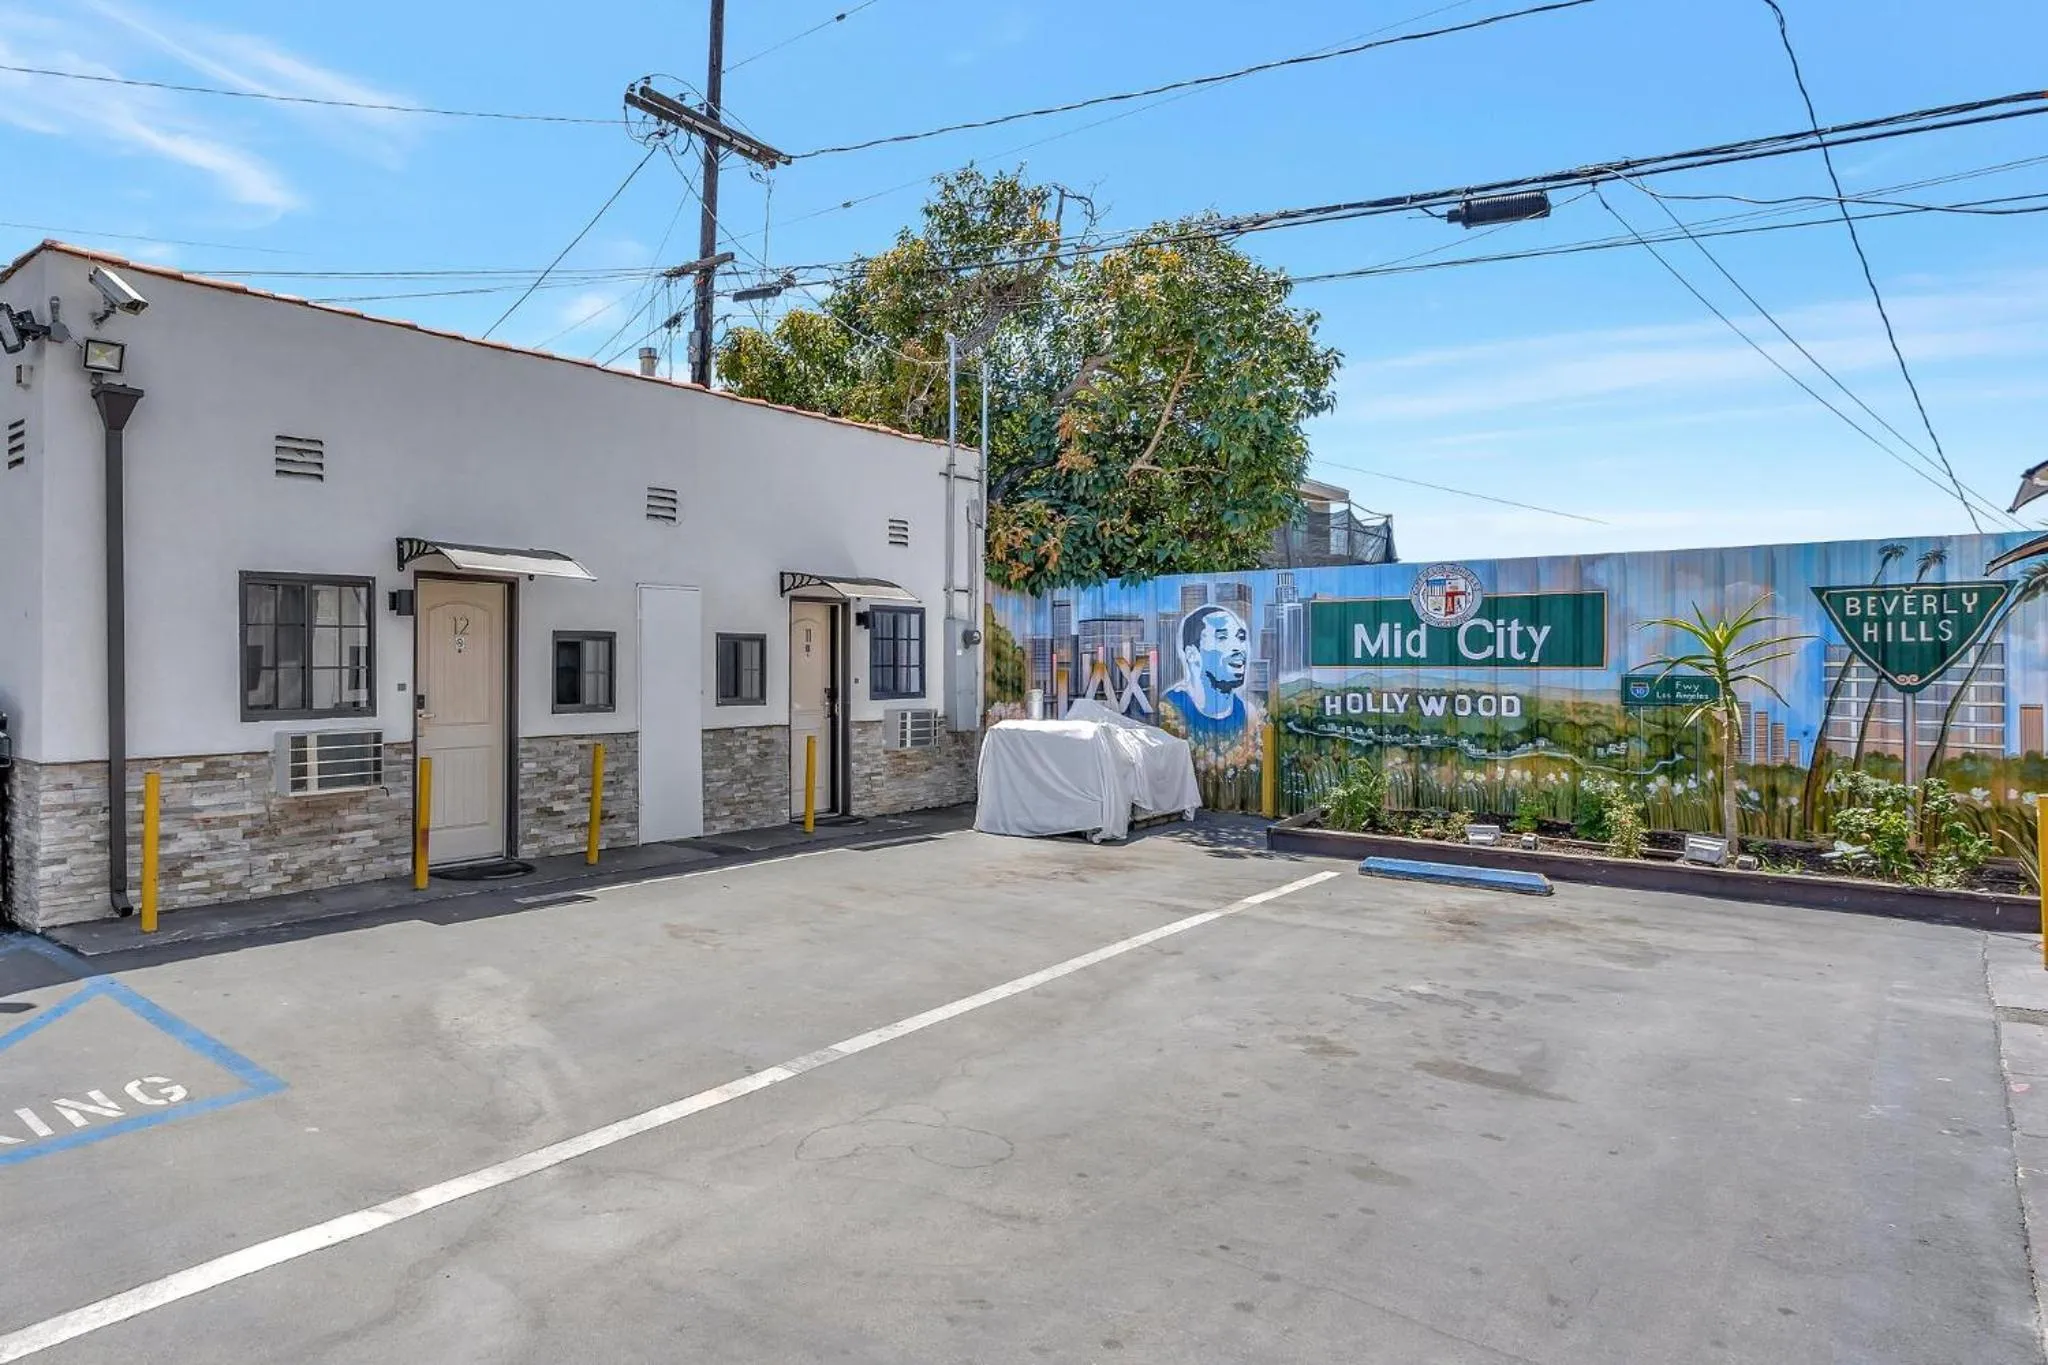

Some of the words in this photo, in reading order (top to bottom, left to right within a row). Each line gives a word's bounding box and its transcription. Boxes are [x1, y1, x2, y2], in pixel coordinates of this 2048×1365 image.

[1845, 591, 1979, 617] BEVERLY
[452, 615, 471, 635] 12
[1862, 618, 1953, 643] HILLS
[1353, 622, 1428, 659] Mid
[1456, 618, 1552, 663] City
[1655, 691, 1672, 699] Los
[1675, 691, 1709, 701] Angeles
[1674, 680, 1700, 692] Fwy
